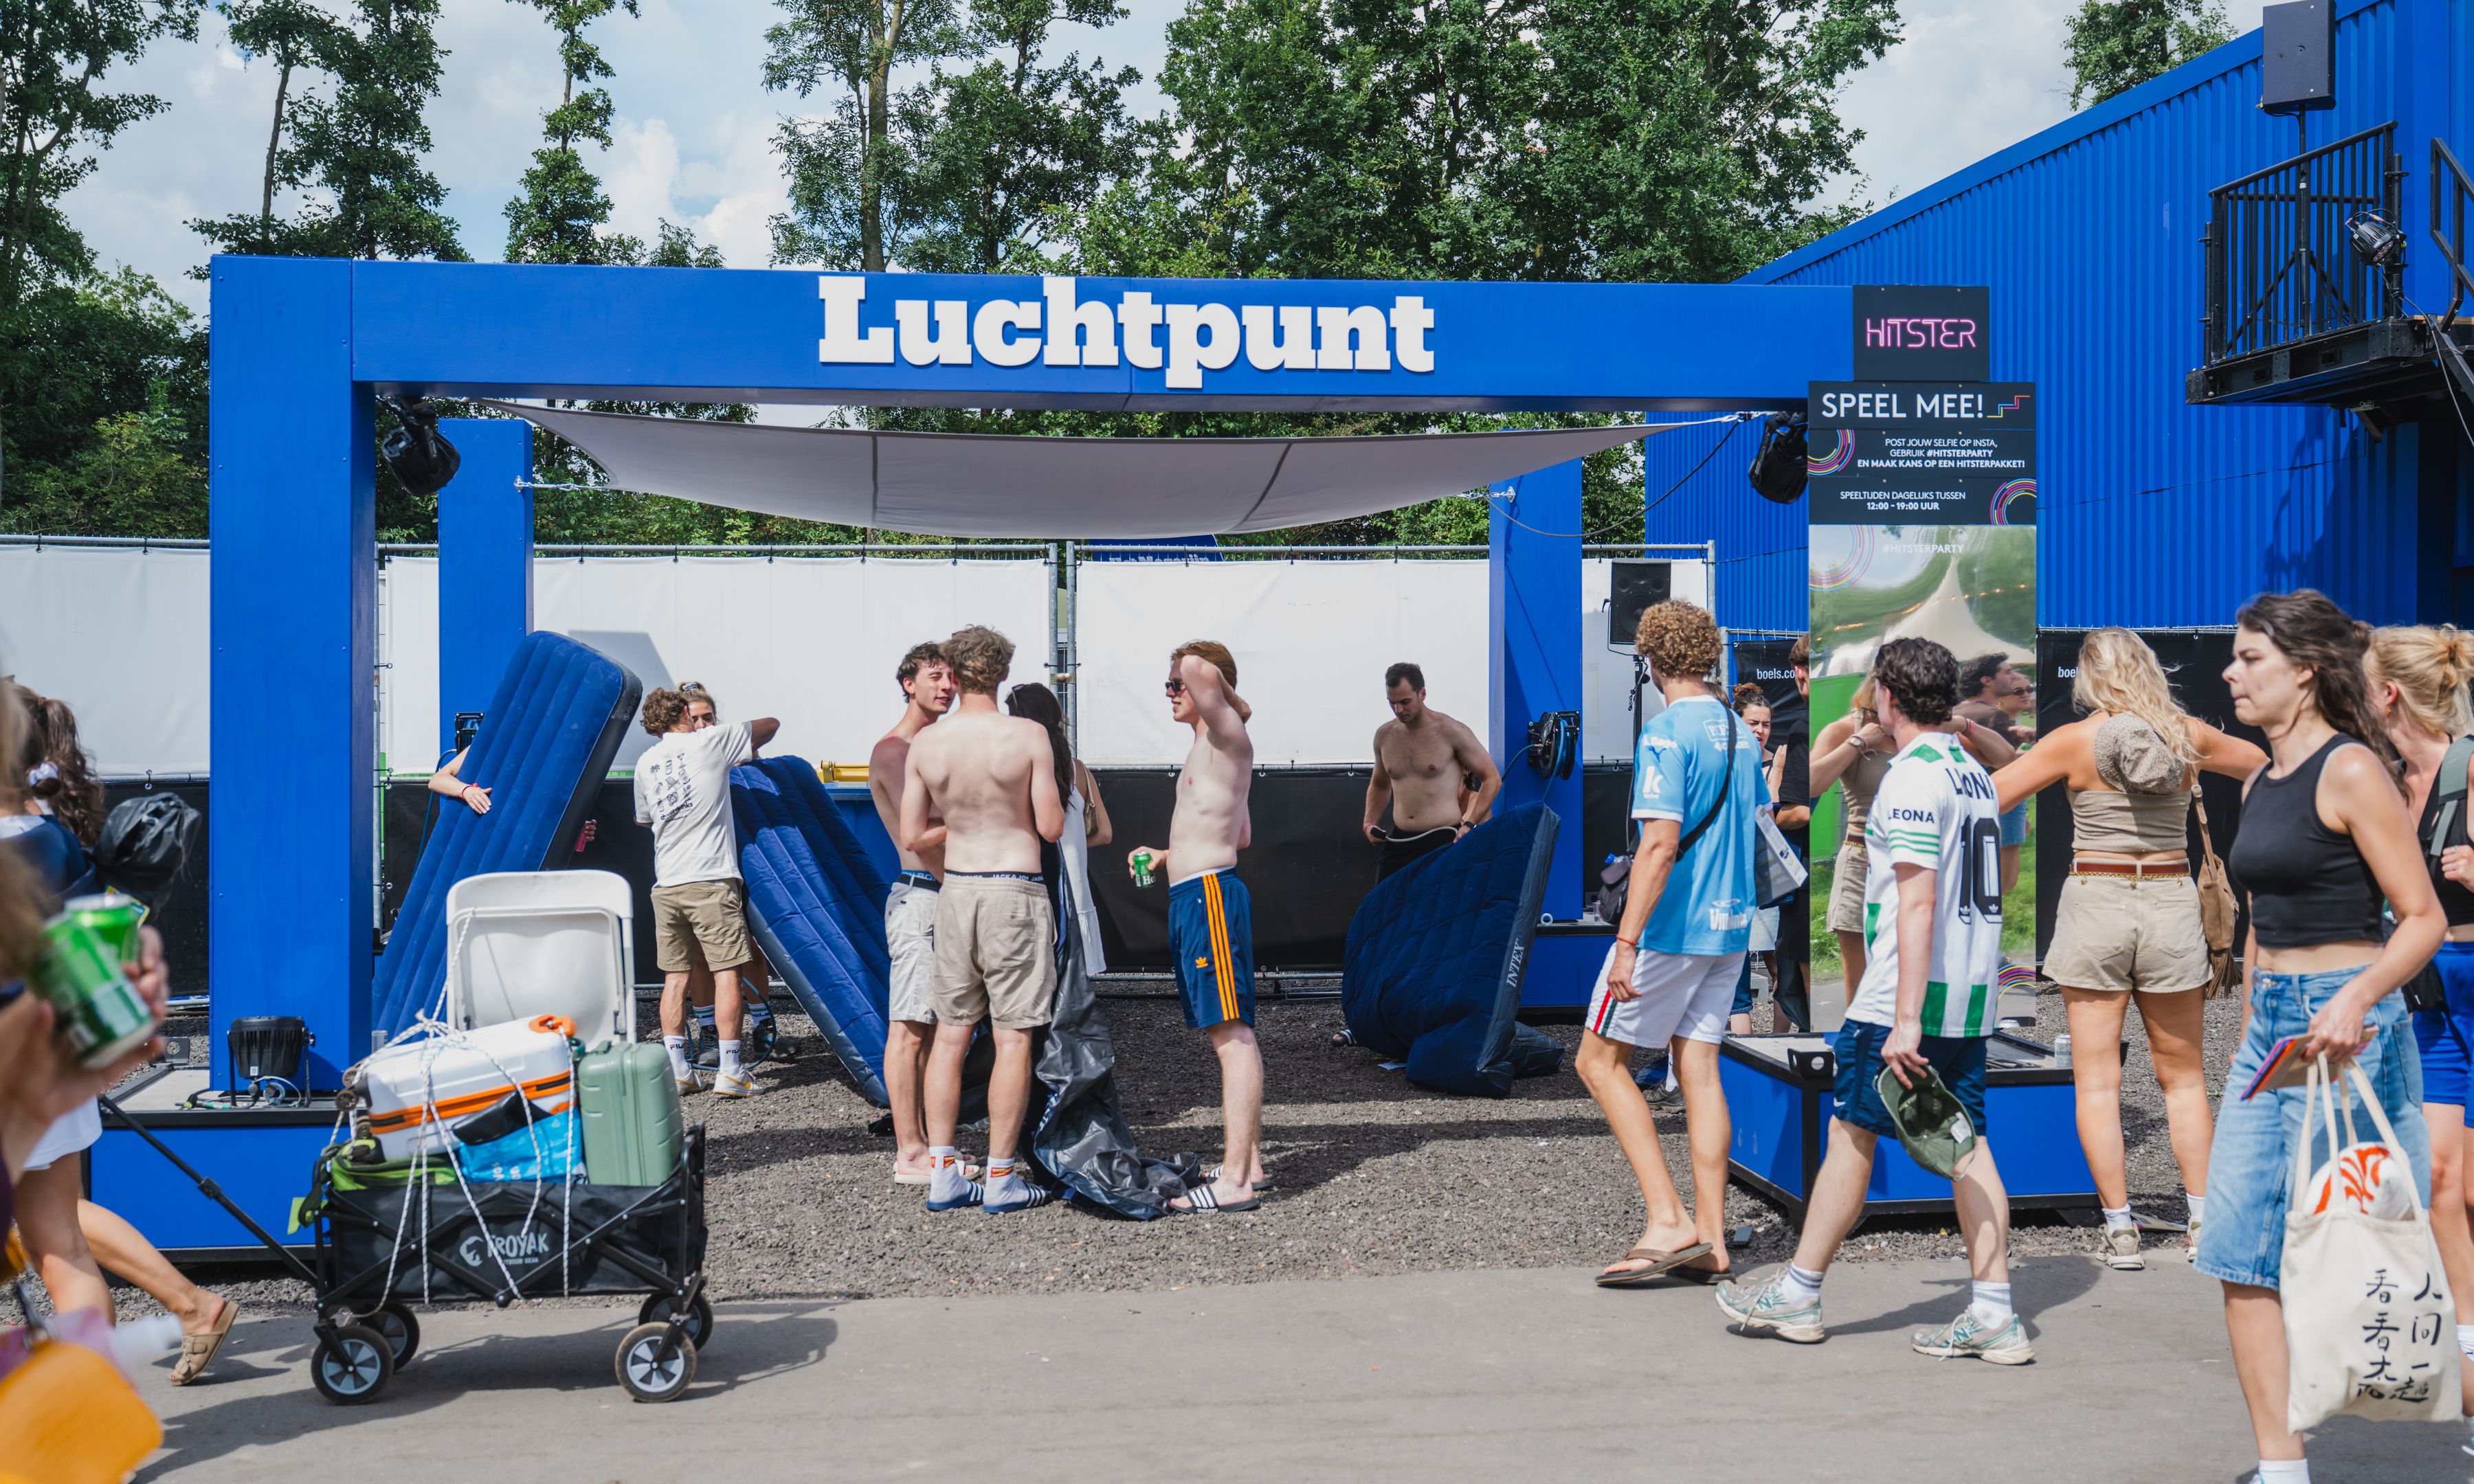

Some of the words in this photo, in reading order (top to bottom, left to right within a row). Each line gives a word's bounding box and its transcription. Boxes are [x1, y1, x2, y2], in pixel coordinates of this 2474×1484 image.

[818, 275, 1434, 389] Luchtpunt
[1866, 318, 1976, 348] HITSTER
[1821, 392, 1906, 418] SPEEL
[1917, 393, 1983, 418] MEE!
[1885, 438, 1906, 447] POST
[1907, 438, 1932, 447] JOUW
[1933, 438, 1958, 447] SELFIE
[1959, 438, 1972, 447] OP
[1973, 438, 1998, 448] INSTA,
[1890, 449, 1925, 457] GEBRUIK
[1926, 449, 1993, 457] #HITSTERPARTY
[1939, 460, 1955, 468] EEN
[1957, 460, 2025, 468] HITSTERPAKKET!
[1840, 491, 1890, 499] SPEELTIJDEN
[1891, 491, 1935, 499] DAGELIJKS
[1935, 491, 1965, 499] TUSSEN
[1883, 544, 1964, 554] #HITSTERPARTY
[1757, 668, 1796, 679] boels.co
[2058, 666, 2079, 678] boel
[1888, 808, 1935, 823] EONA
[1959, 815, 2003, 925] 10
[1506, 941, 1524, 988] INTEX
